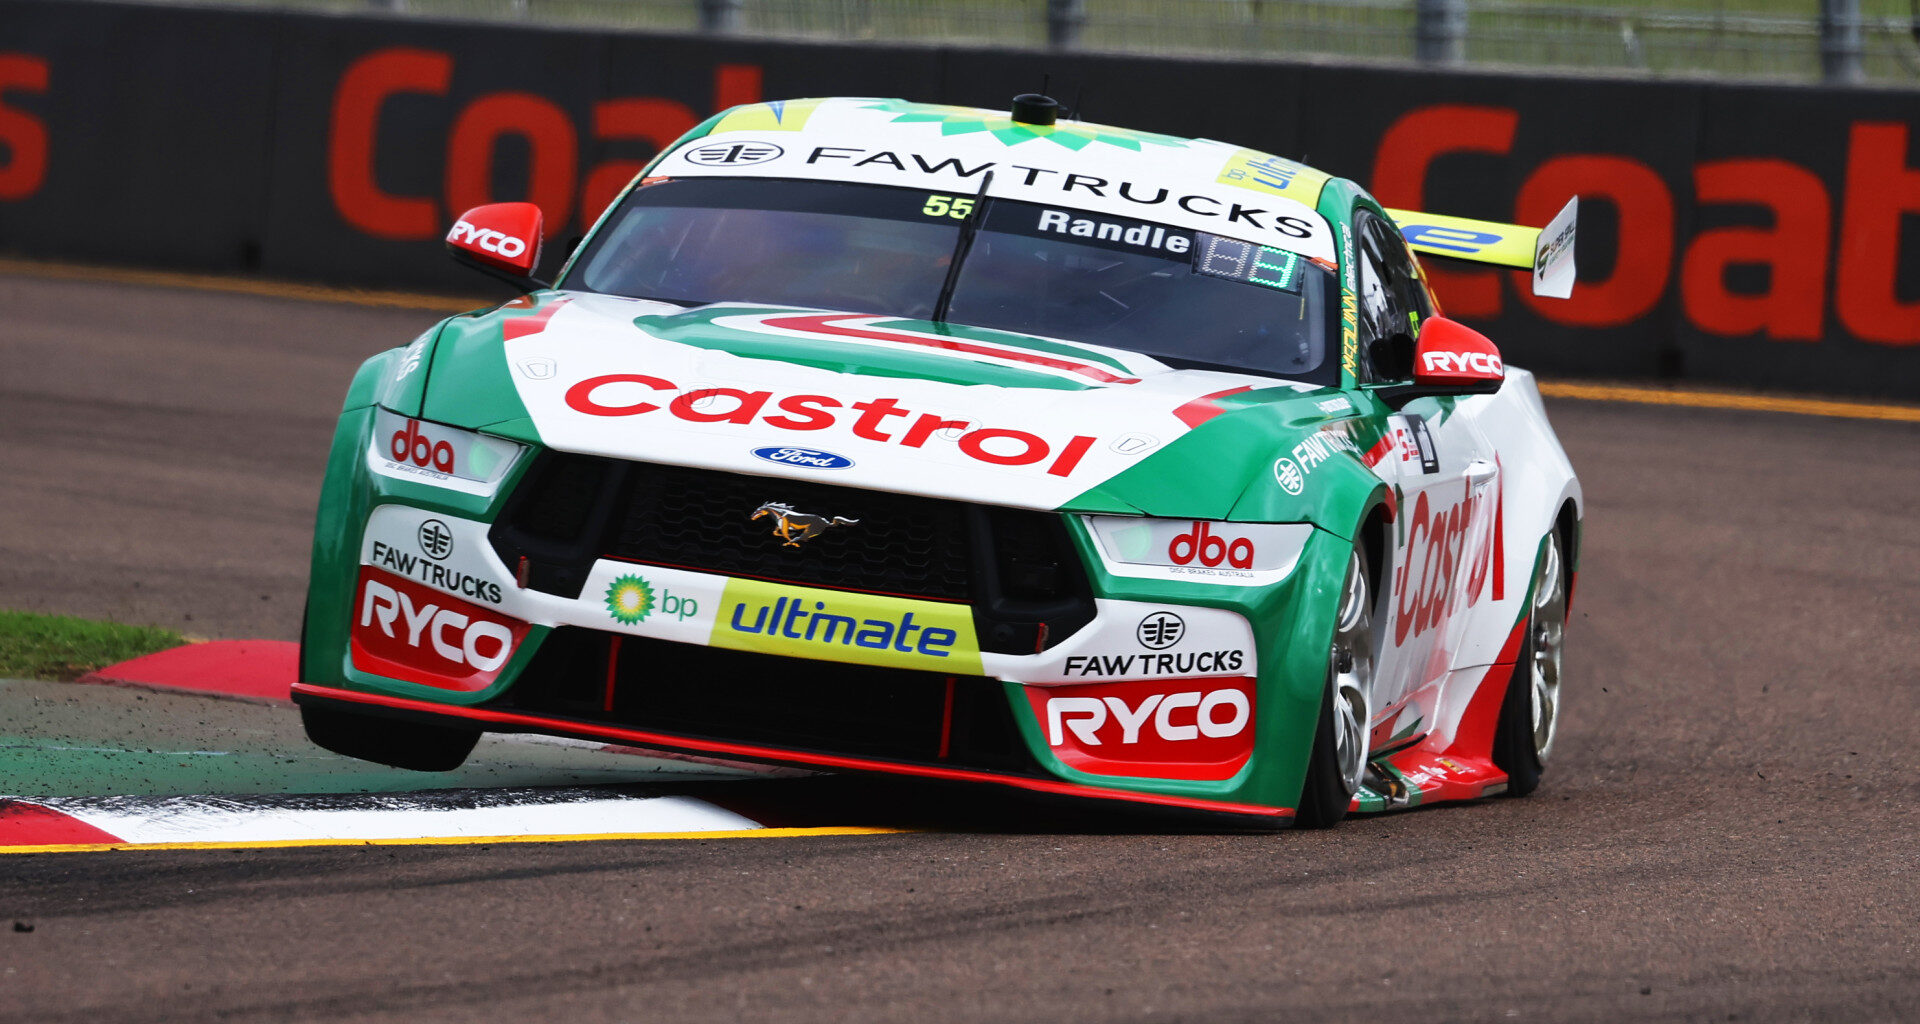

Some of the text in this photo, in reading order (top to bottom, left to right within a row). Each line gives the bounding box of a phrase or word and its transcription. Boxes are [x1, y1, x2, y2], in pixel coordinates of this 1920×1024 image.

[806, 147, 1315, 239] FAW TRUCKS
[922, 195, 976, 220] 55
[448, 220, 525, 257] RYCO
[1038, 210, 1191, 254] Randle
[1423, 351, 1503, 377] RYCO
[391, 418, 454, 474] dba
[564, 373, 1098, 478] Castrol
[770, 448, 835, 467] Ford
[1292, 433, 1331, 474] FAW
[1168, 521, 1255, 570] dba
[373, 541, 502, 604] FAW TRUCKS
[360, 579, 513, 673] RYCO
[662, 589, 698, 621] bp
[731, 597, 956, 657] ultimate
[1063, 650, 1244, 676] FAW TRUCKS
[1047, 688, 1250, 746] RYCO
